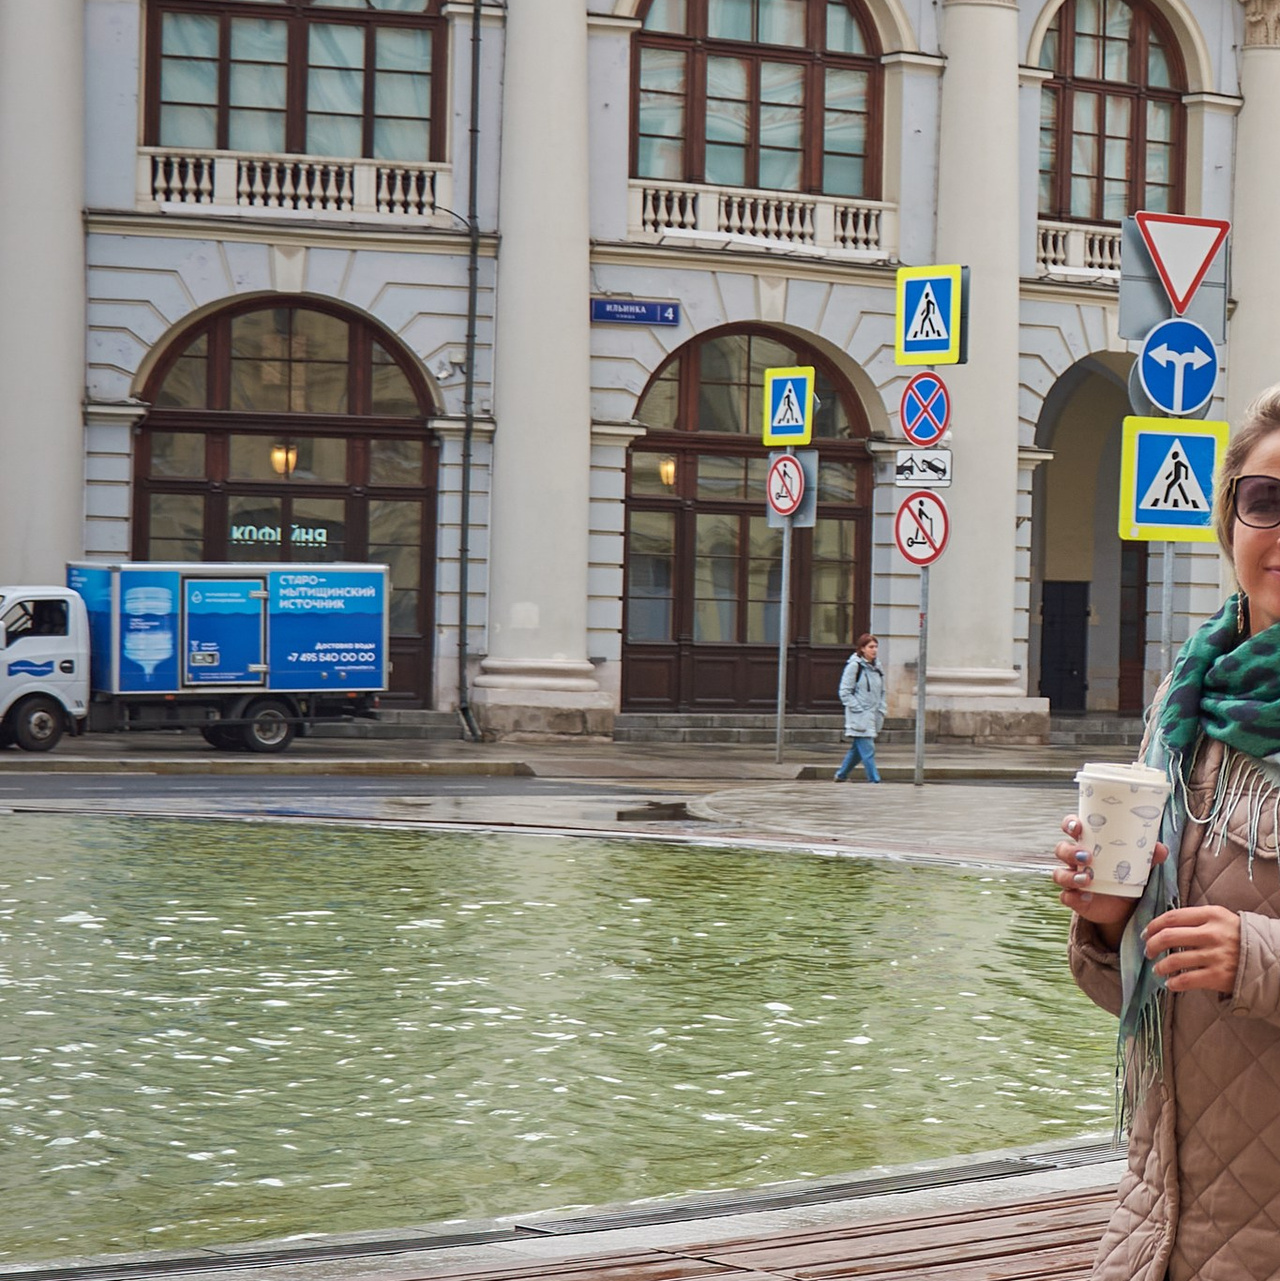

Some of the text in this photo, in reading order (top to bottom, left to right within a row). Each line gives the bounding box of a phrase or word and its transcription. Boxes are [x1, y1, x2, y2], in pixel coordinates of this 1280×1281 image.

[606, 304, 646, 314] ИЛЬИНКА
[664, 307, 674, 320] 4
[279, 586, 376, 598] МЫТИЩИНСКИЙ
[279, 599, 345, 609] ИСТОЧНИК
[287, 652, 376, 662] +7 495 540 00 00
